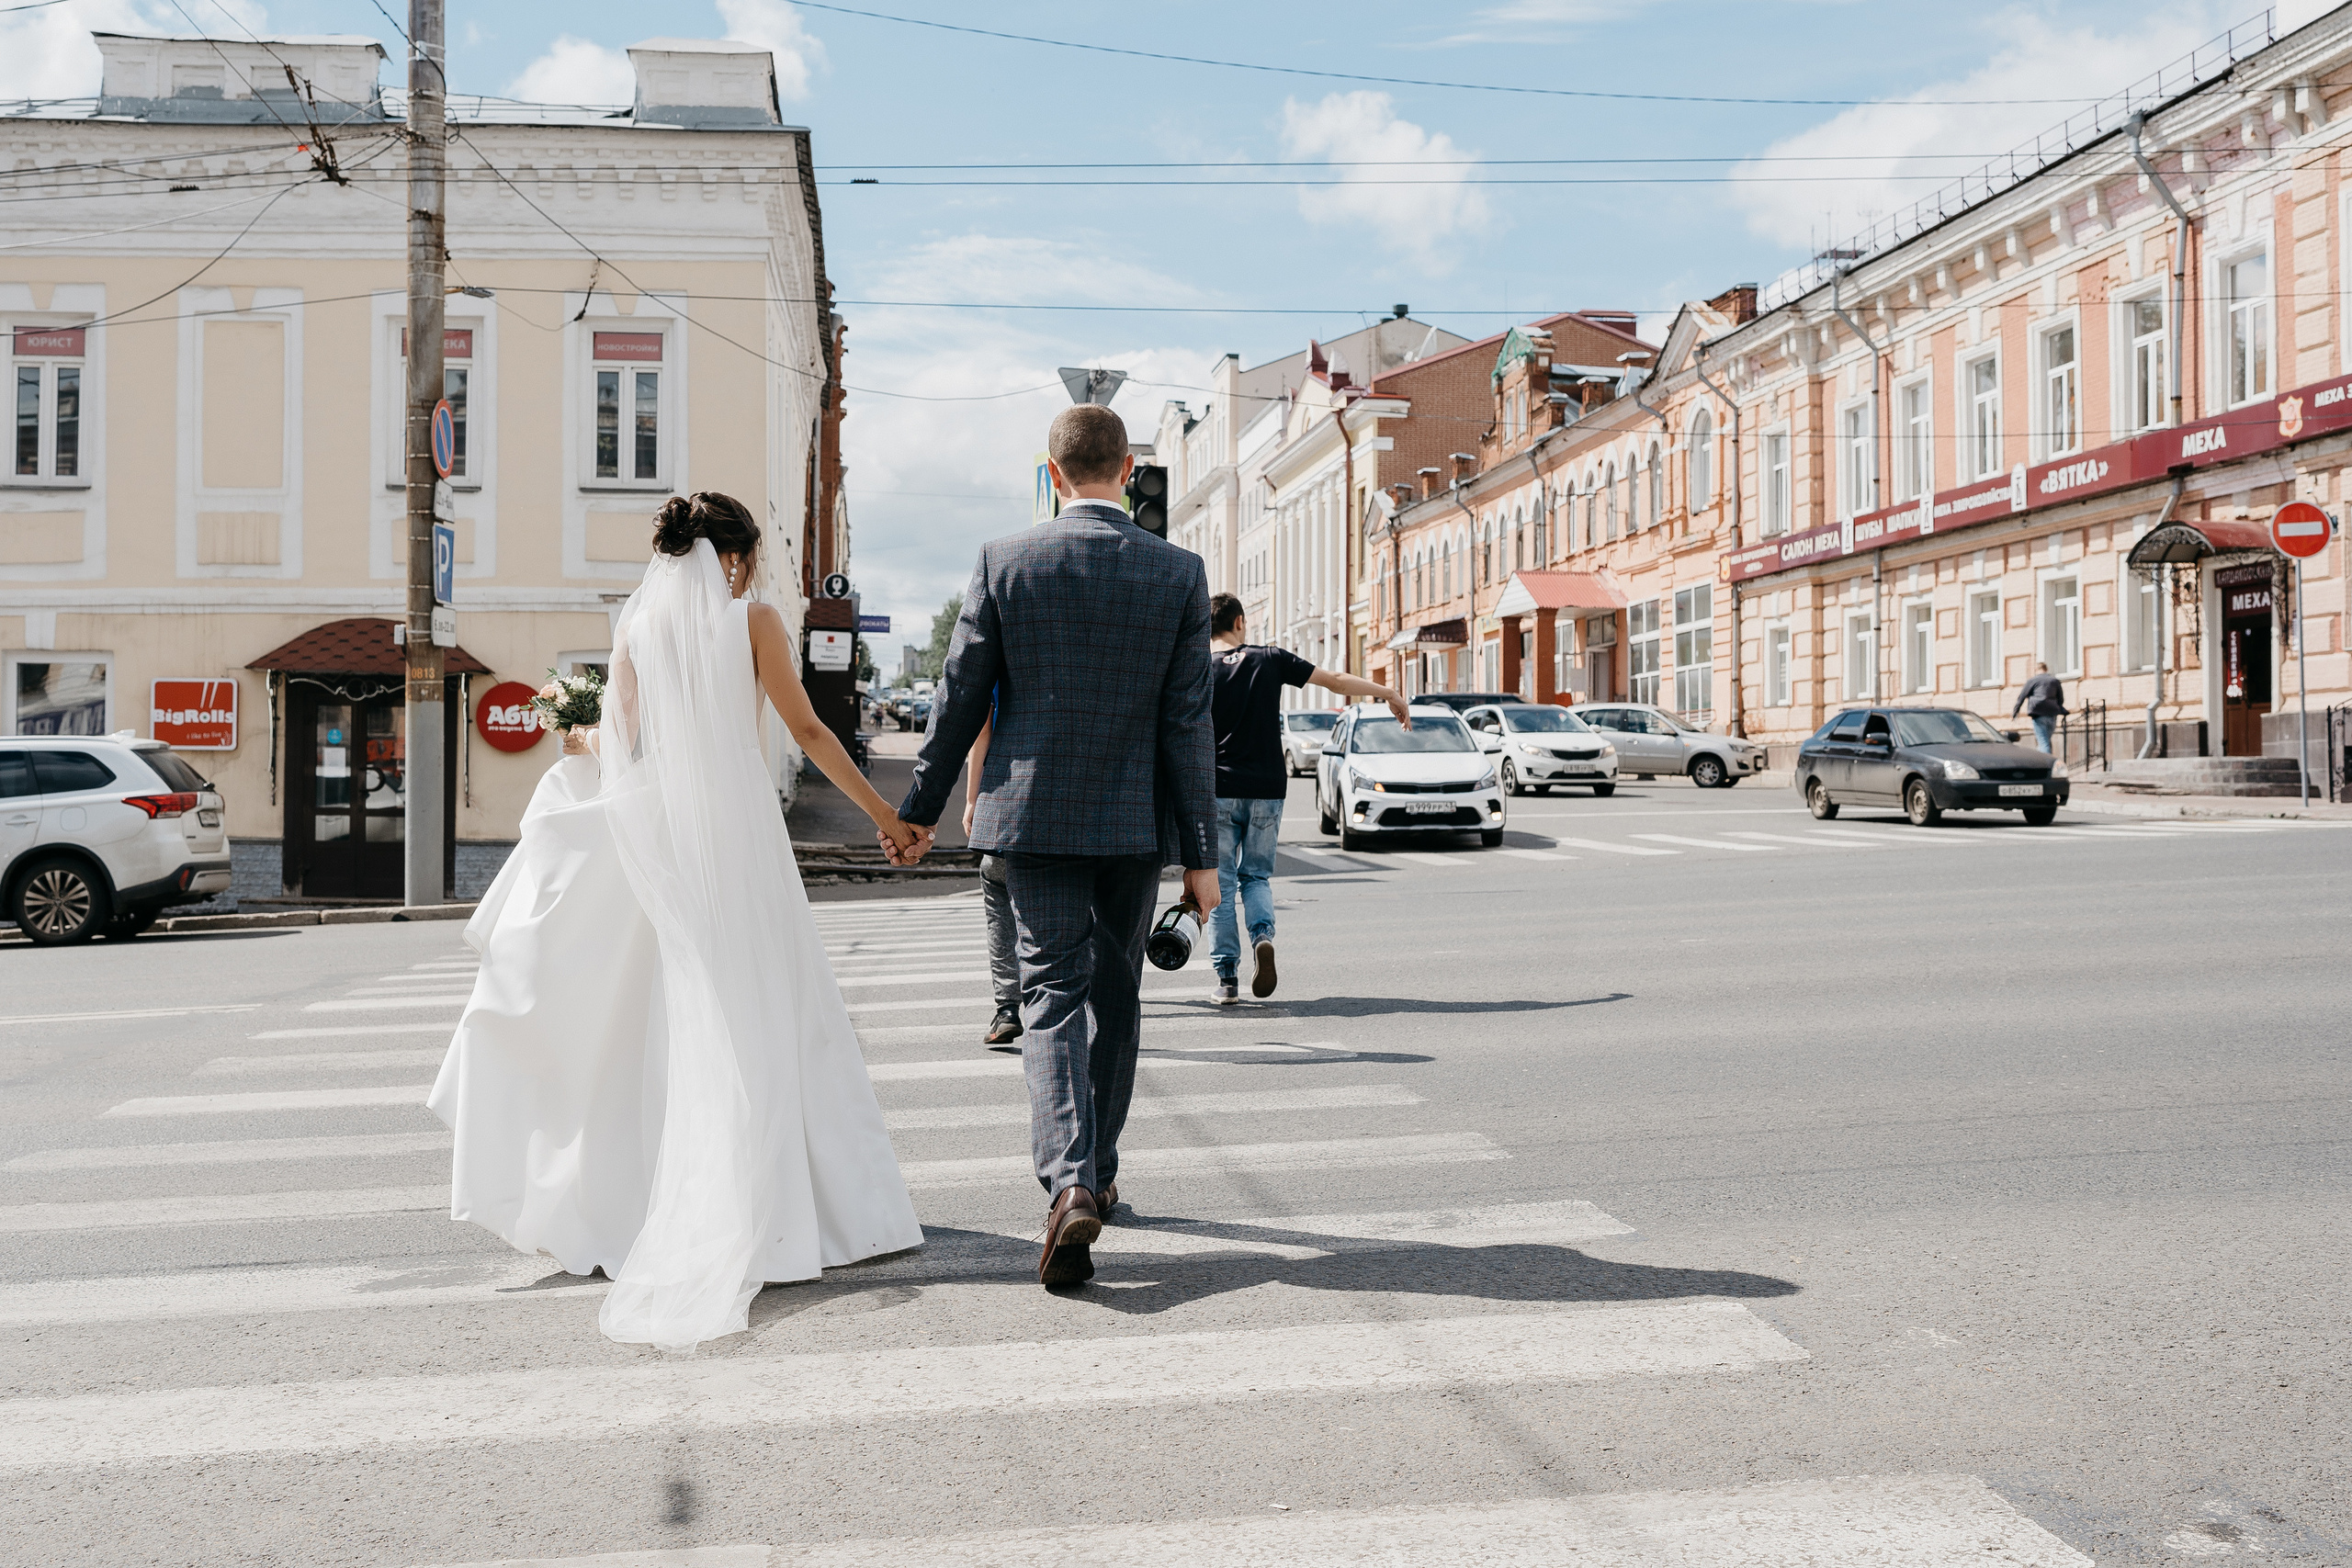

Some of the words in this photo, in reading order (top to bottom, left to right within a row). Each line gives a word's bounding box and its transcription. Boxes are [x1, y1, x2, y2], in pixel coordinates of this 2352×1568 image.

[28, 336, 73, 347] ЮРИСТ
[597, 344, 659, 353] НОВОСТРОЙКИ
[2314, 386, 2346, 408] МЕХА
[2182, 426, 2226, 457] МЕХА
[2040, 459, 2109, 493] «ВЯТКА»
[1855, 518, 1883, 542] ШУБЫ
[1781, 536, 1814, 562] САЛОН
[1814, 530, 1841, 553] МЕХА
[2232, 591, 2271, 611] МЕХА
[411, 668, 435, 679] 0813
[153, 708, 233, 726] BigRolls
